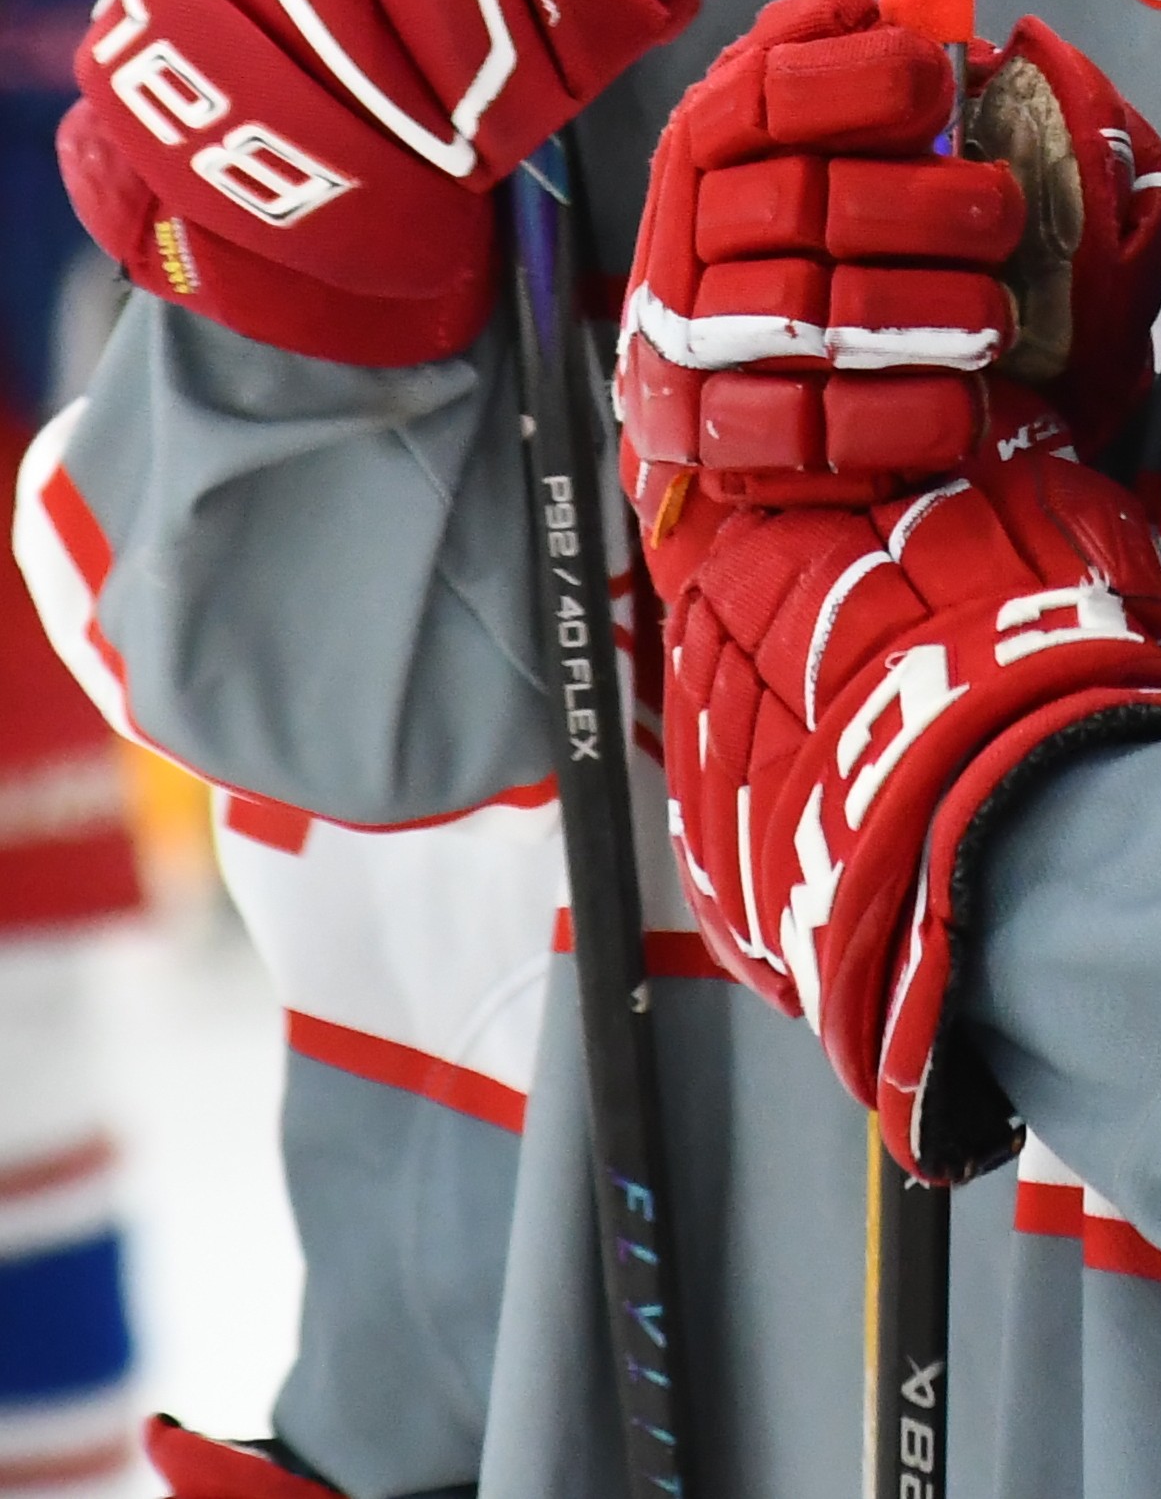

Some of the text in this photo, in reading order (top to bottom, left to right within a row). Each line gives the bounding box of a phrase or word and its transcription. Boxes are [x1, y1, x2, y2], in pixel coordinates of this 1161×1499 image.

[541, 474, 580, 559] P92
[554, 594, 590, 649] 40
[561, 657, 600, 762] FLEX
[779, 580, 1145, 1036] CCM
